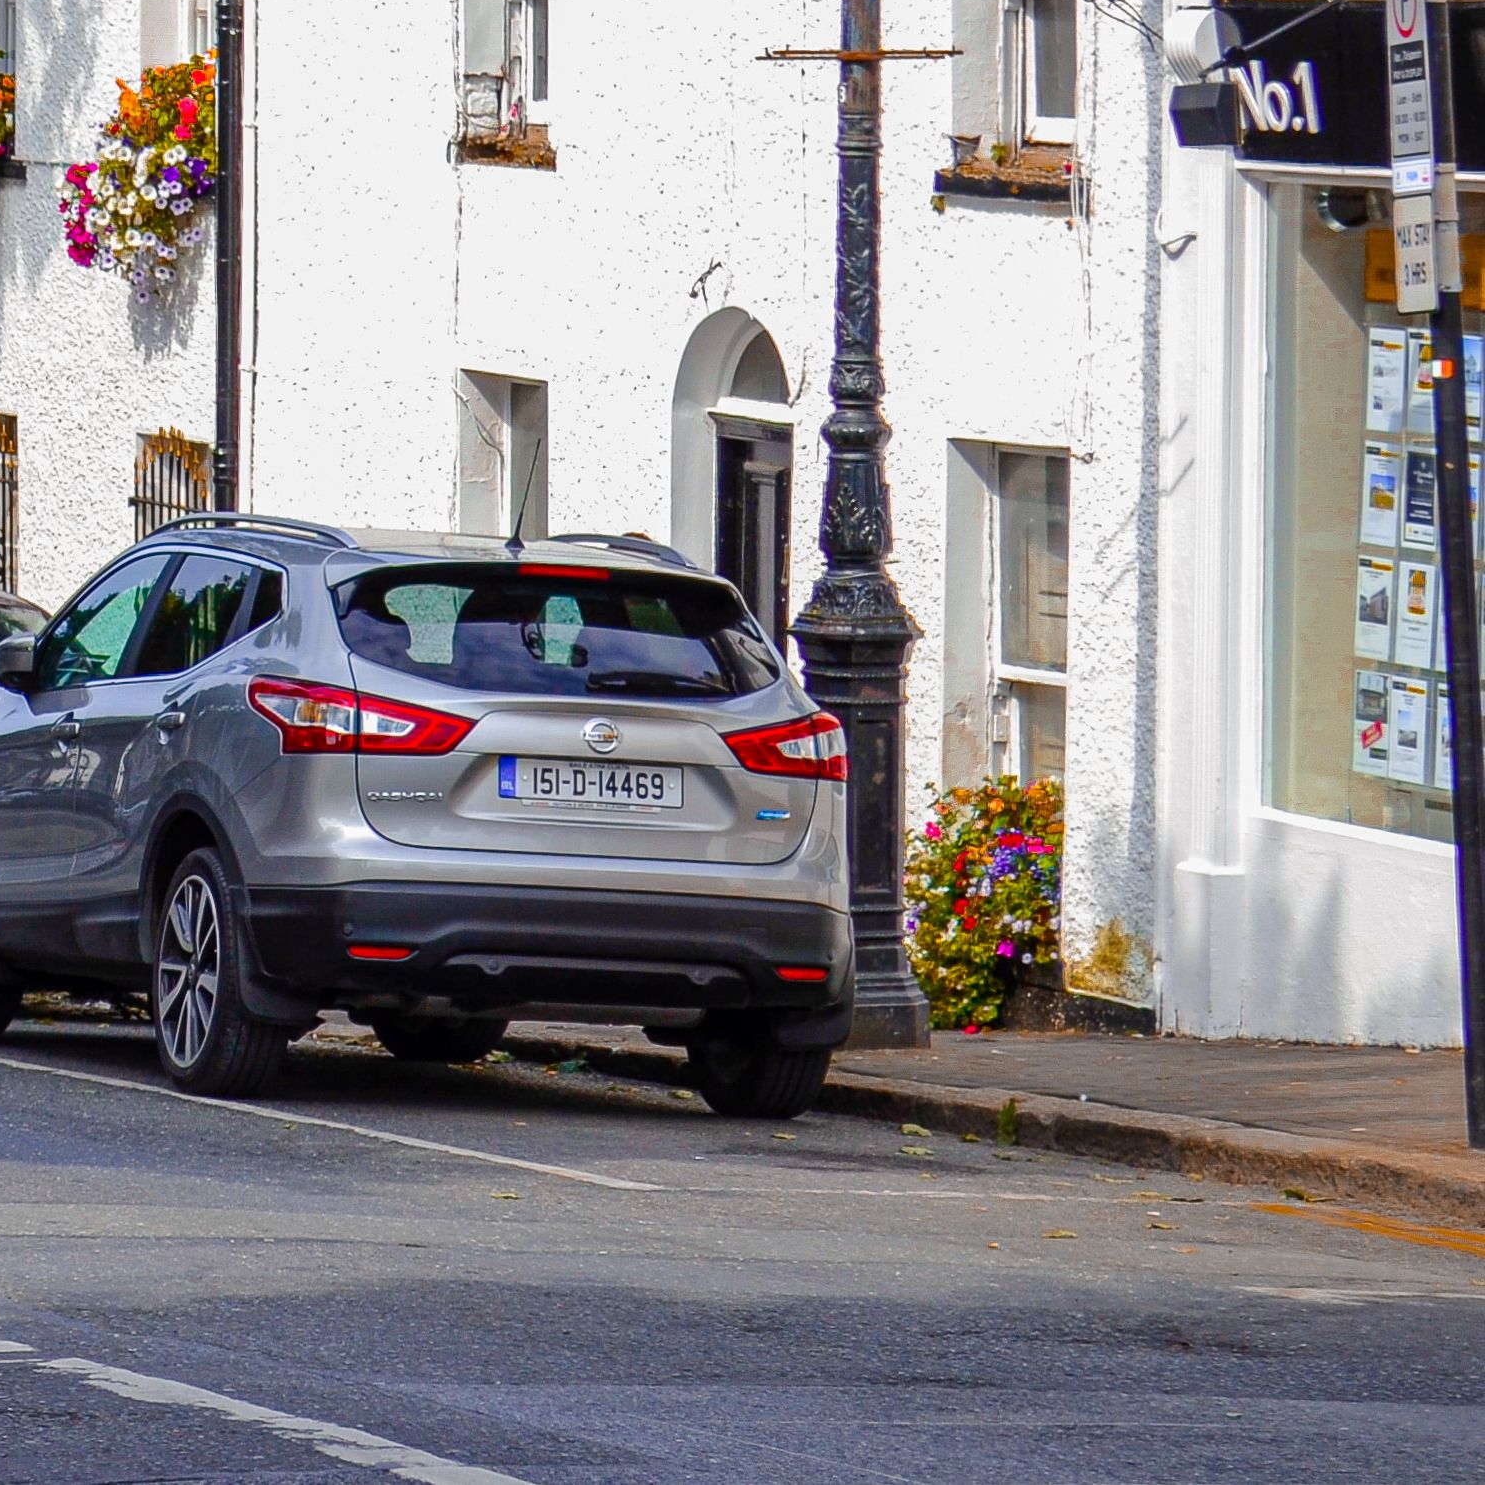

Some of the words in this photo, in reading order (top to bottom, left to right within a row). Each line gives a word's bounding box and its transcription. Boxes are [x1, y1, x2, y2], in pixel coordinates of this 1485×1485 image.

[1228, 59, 1321, 135] No.1
[1396, 225, 1412, 248] MAX
[1414, 223, 1430, 246] STAY
[1404, 263, 1410, 287] 3
[1411, 261, 1427, 285] HRS
[501, 780, 515, 791] IRL
[532, 767, 665, 800] 151-D-14469
[367, 790, 444, 803] QASHQAI
